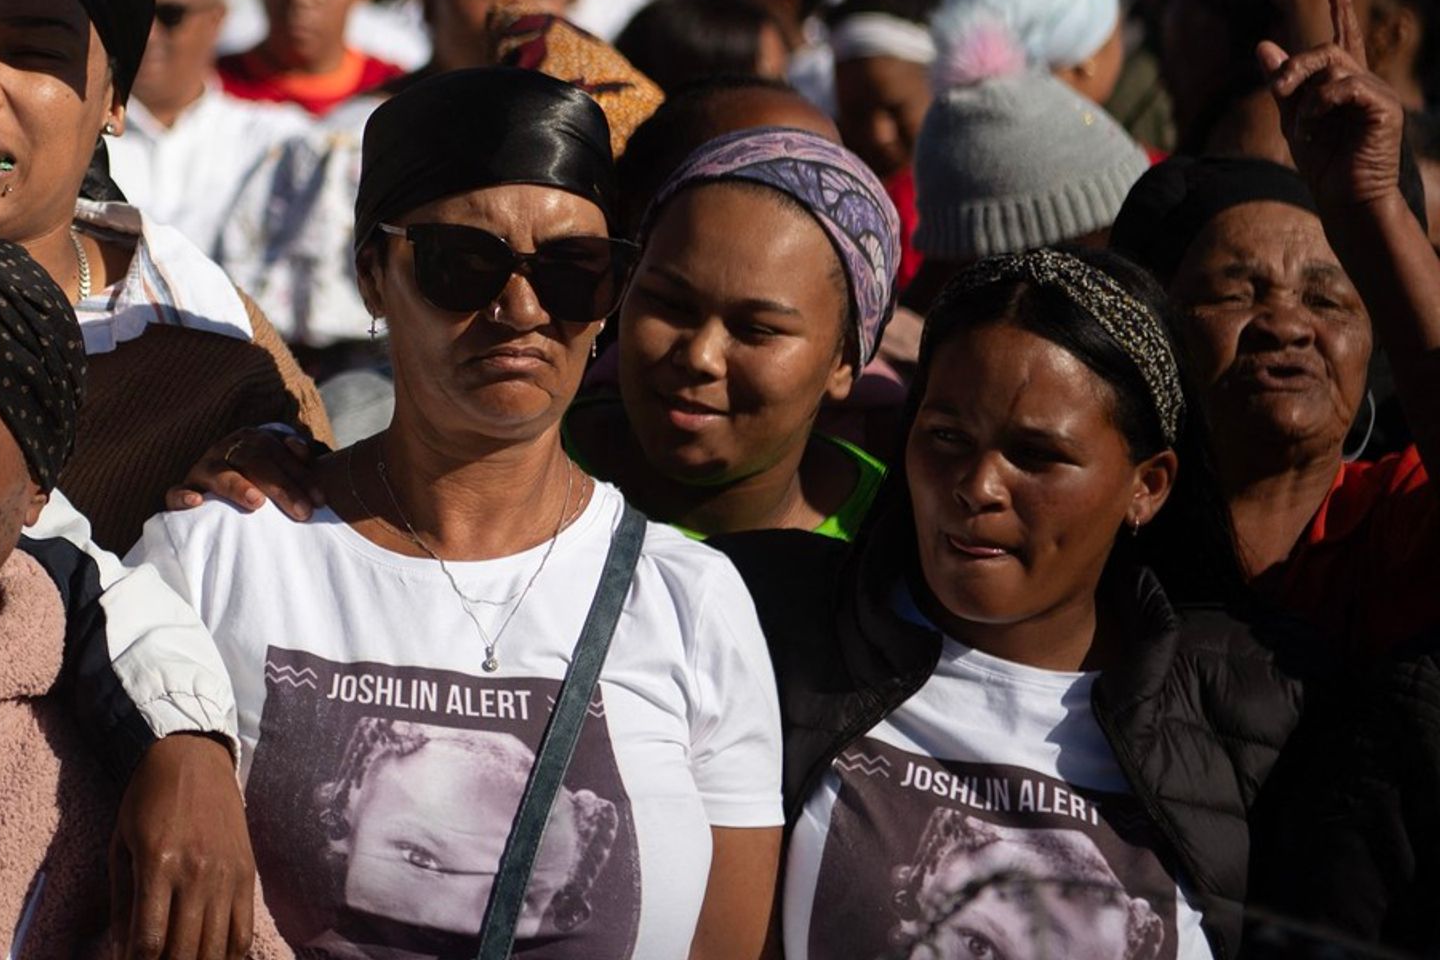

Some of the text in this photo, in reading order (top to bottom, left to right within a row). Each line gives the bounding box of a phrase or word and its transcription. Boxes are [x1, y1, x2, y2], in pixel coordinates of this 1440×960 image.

[327, 673, 532, 721] JOSHLIN ALERT
[900, 761, 1102, 827] JOSHLIN ALERT
